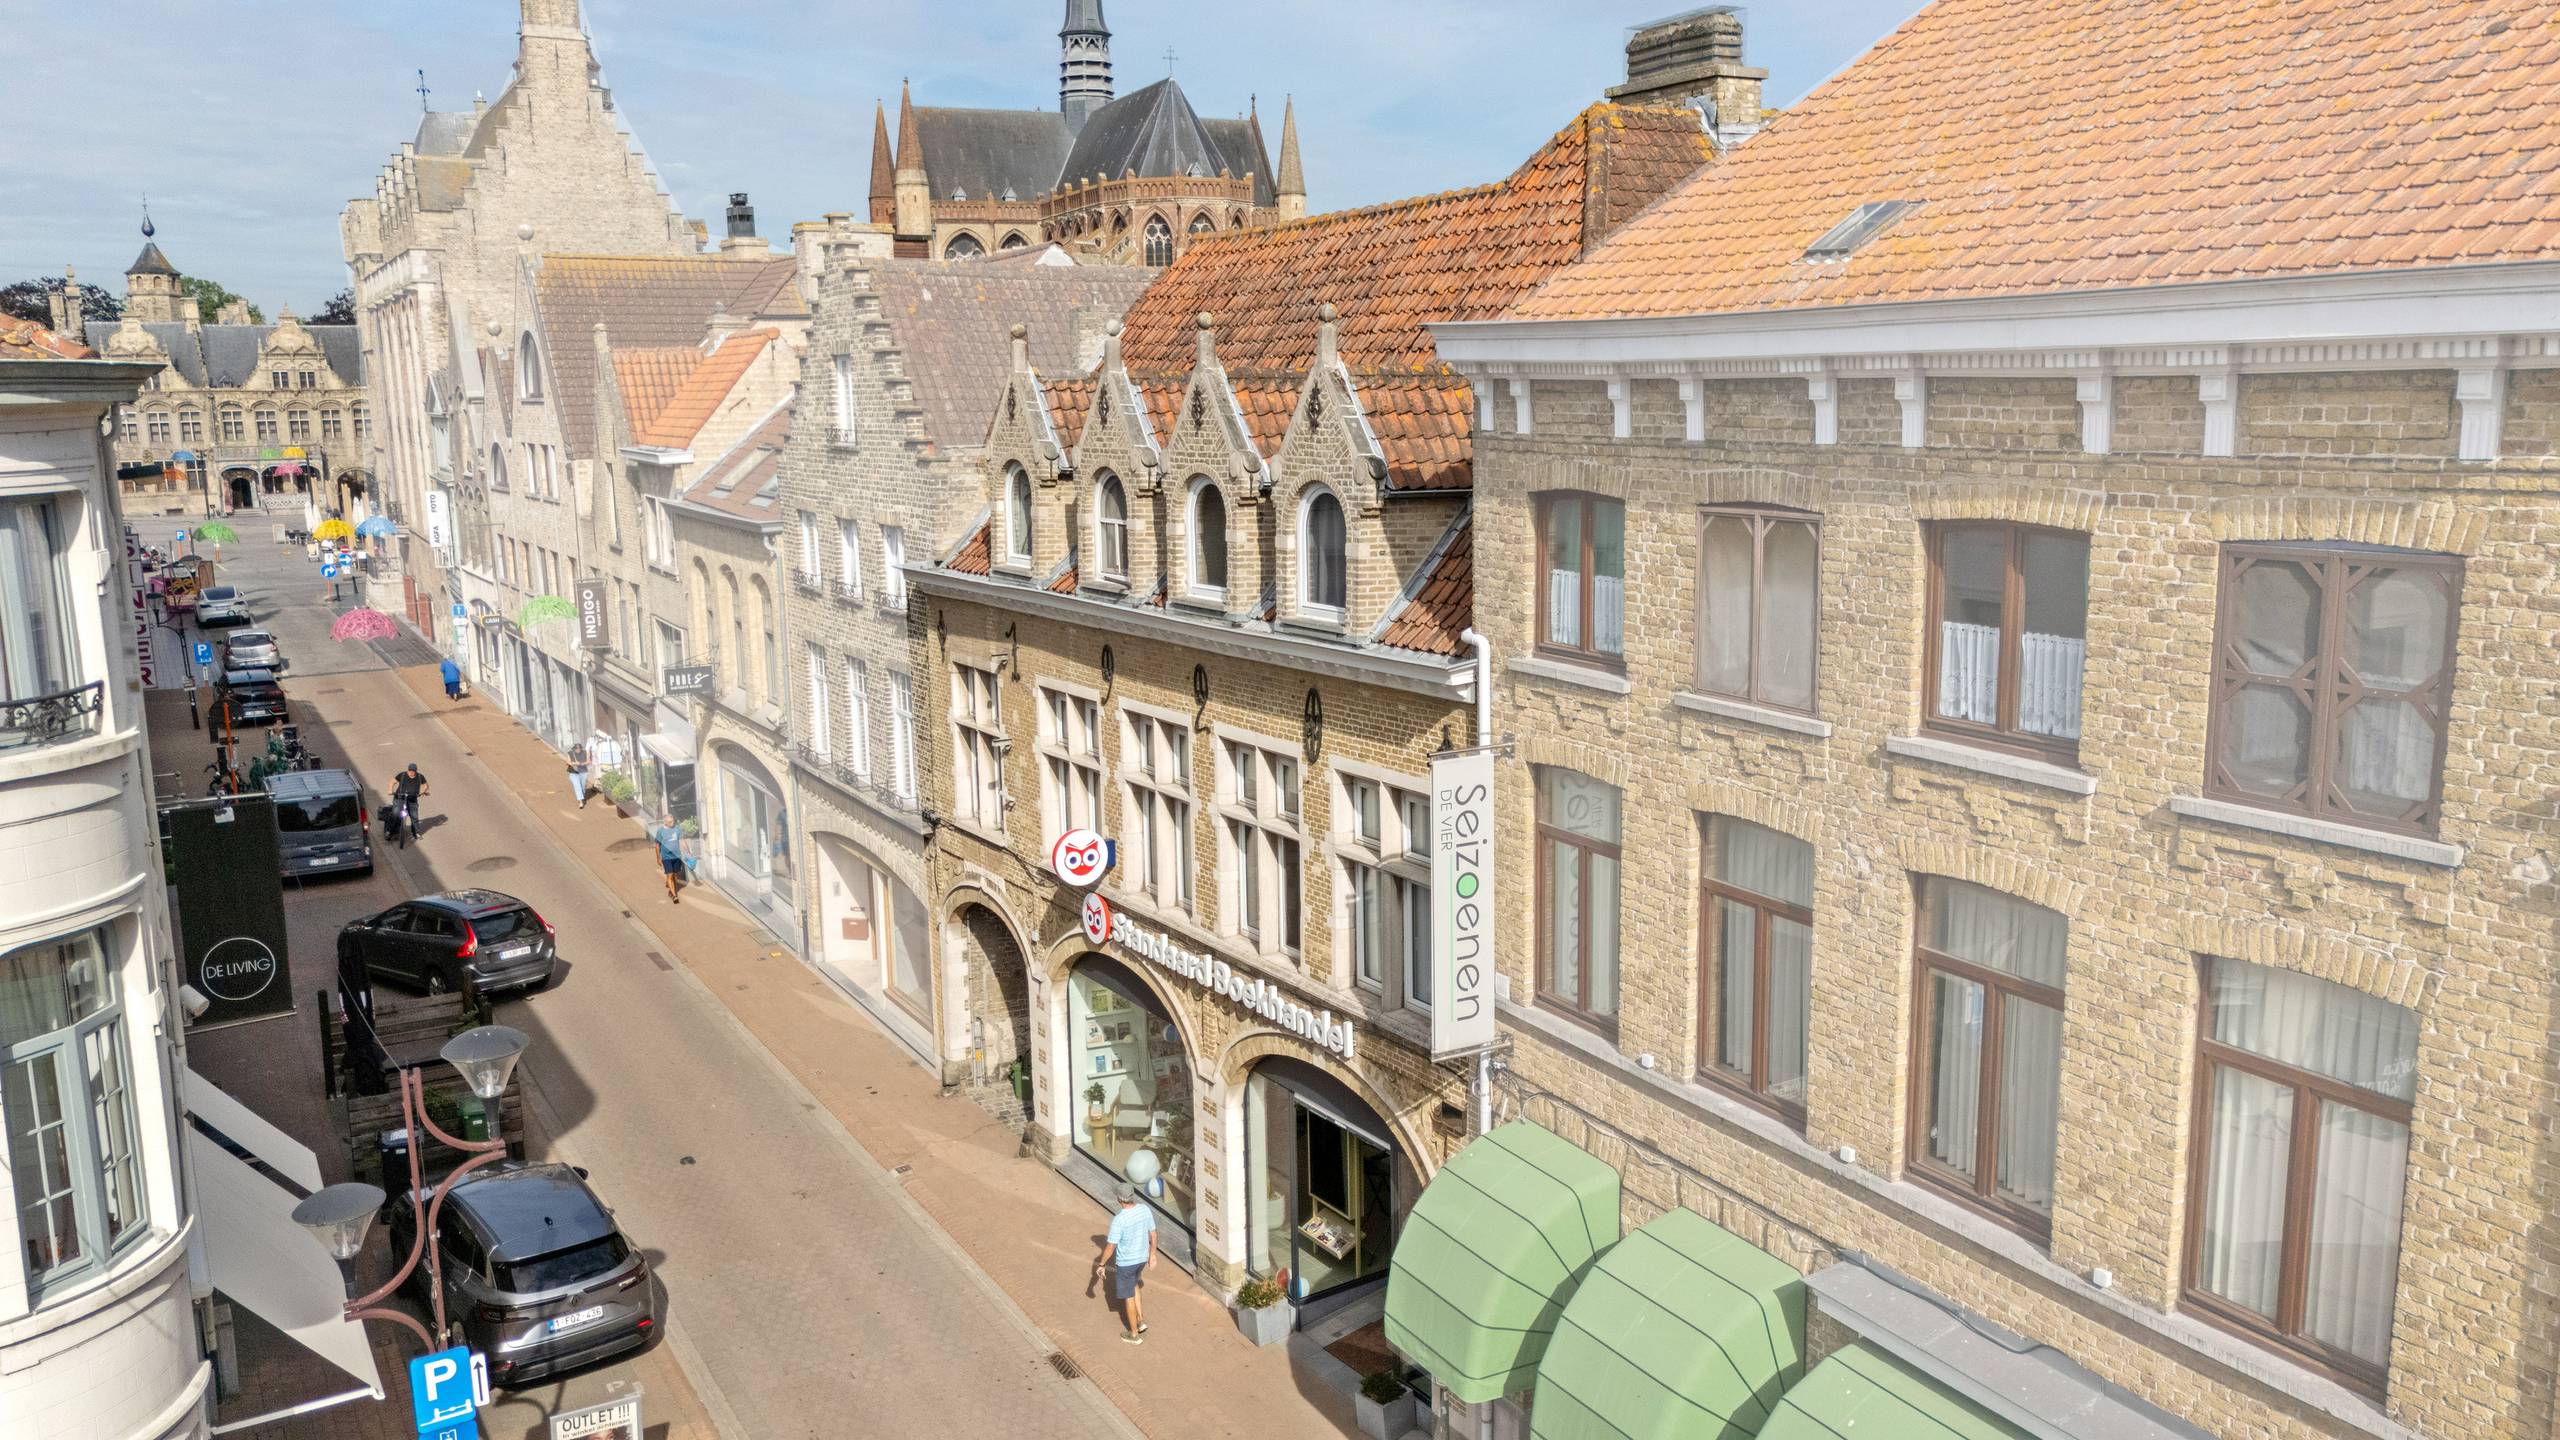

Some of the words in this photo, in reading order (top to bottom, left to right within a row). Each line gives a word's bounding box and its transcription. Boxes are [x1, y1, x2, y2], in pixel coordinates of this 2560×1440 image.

[583, 589, 597, 638] INDIGO
[197, 644, 207, 656] P
[1440, 789, 1453, 812] DE
[1441, 819, 1453, 851] VIER
[1455, 783, 1488, 1021] Seizoenen
[205, 964, 224, 979] DE
[226, 958, 271, 976] LIVING
[1111, 912, 1213, 988] Standaard
[1213, 960, 1354, 1058] Boekhandel
[424, 1358, 457, 1402] P
[562, 1408, 614, 1432] OUTLET
